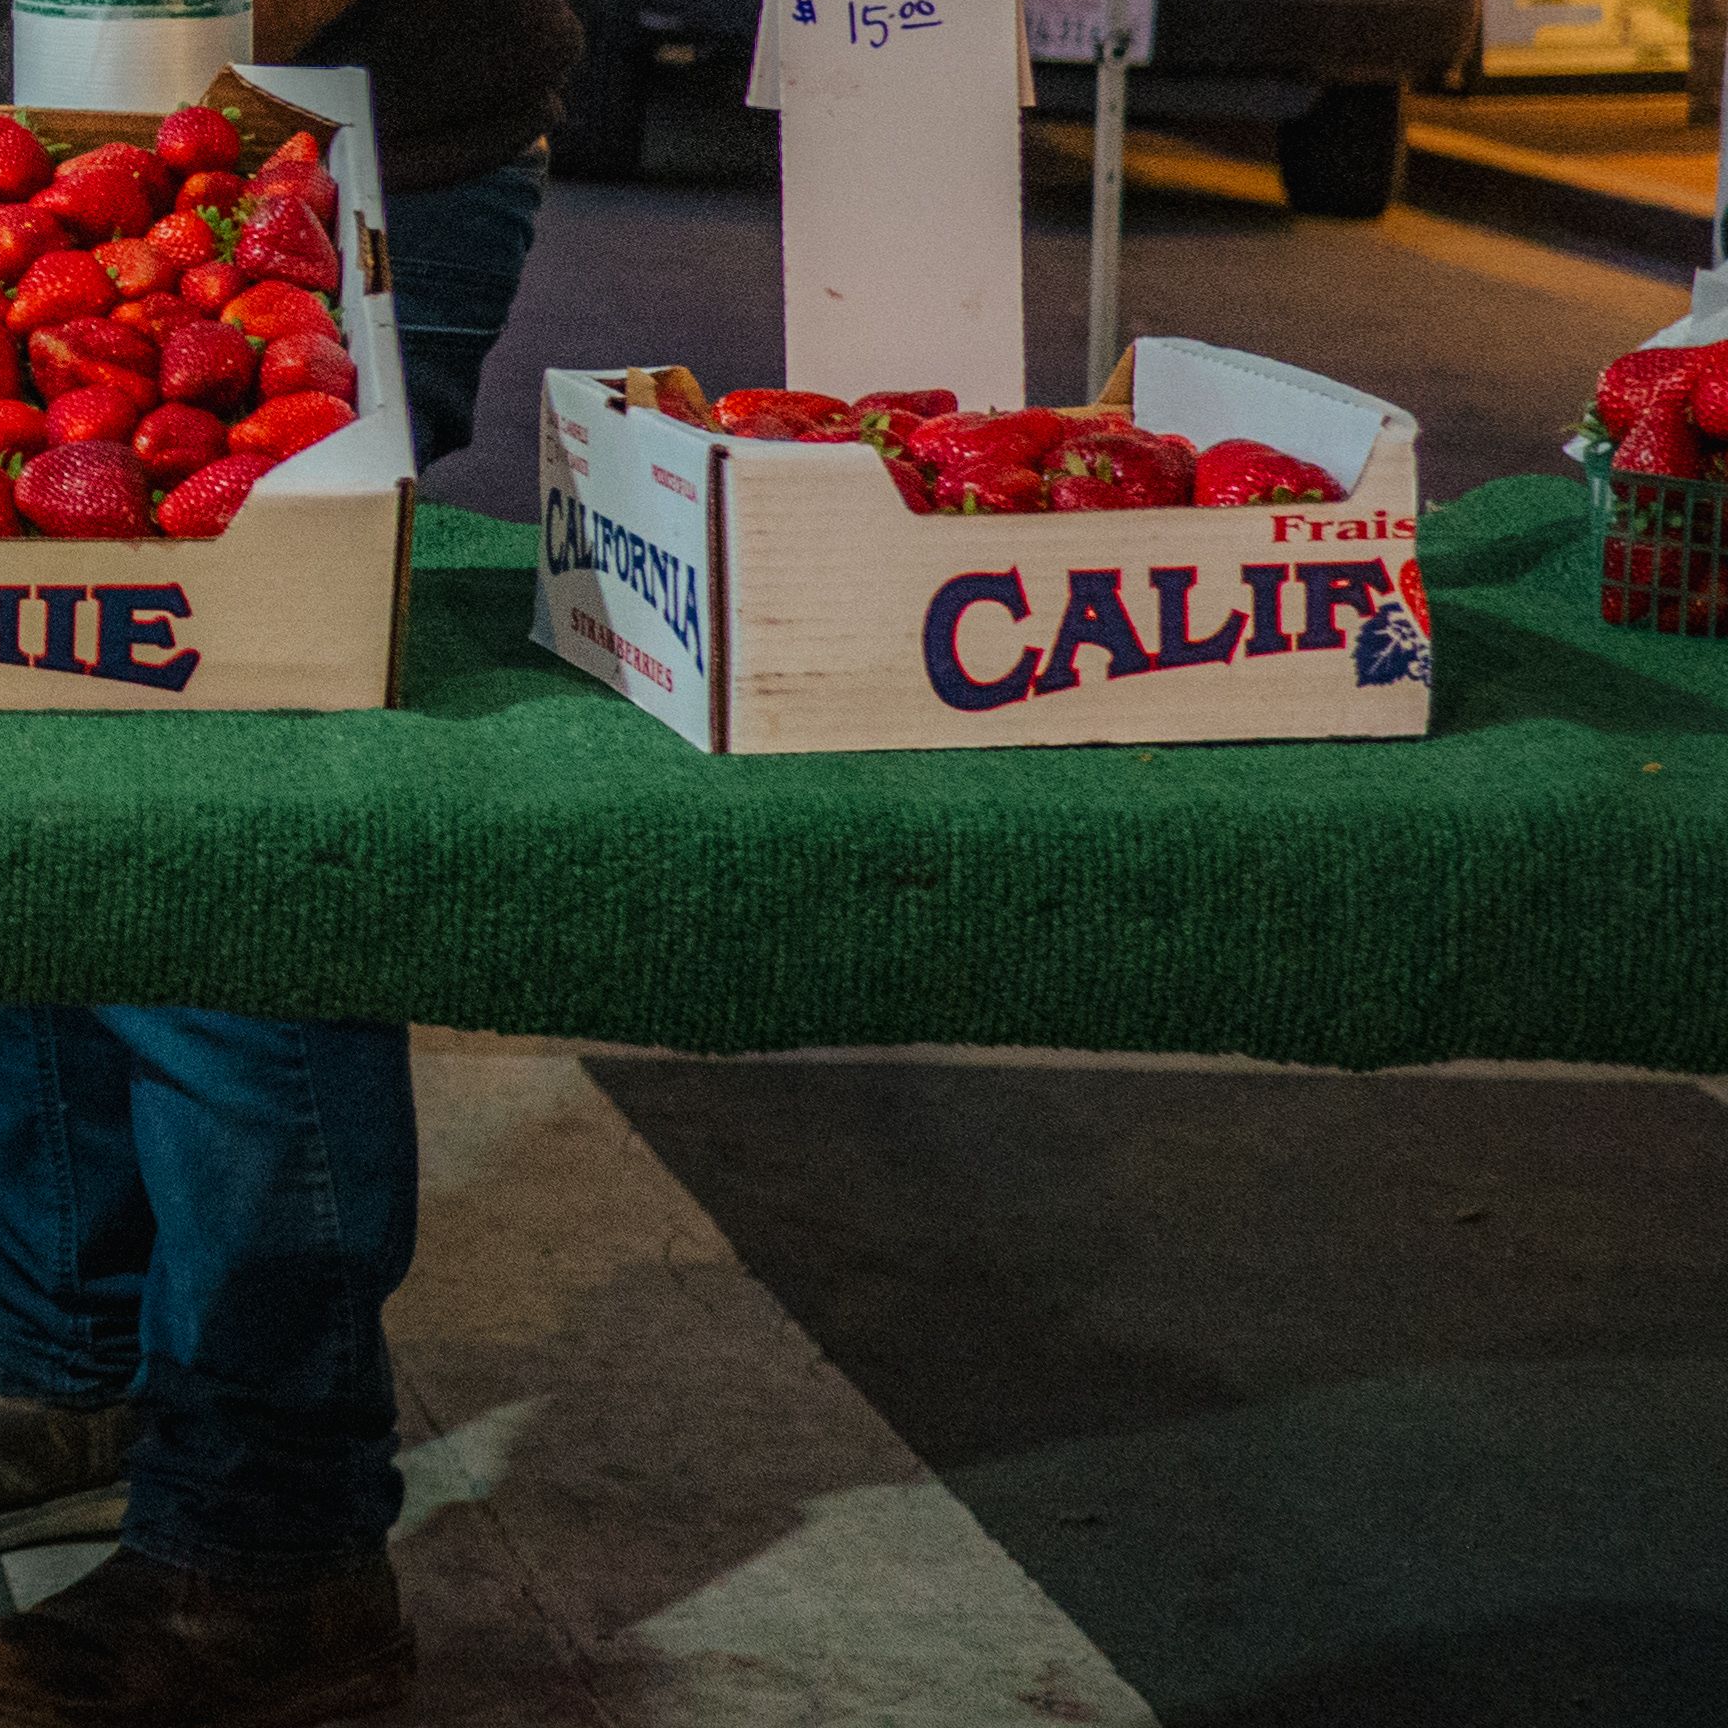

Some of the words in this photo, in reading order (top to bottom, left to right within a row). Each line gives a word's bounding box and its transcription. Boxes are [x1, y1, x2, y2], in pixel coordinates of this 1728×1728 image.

[1271, 510, 1417, 543] Frais
[545, 486, 704, 678] CALIFORNIA
[571, 606, 674, 694] STRAWBERRIES
